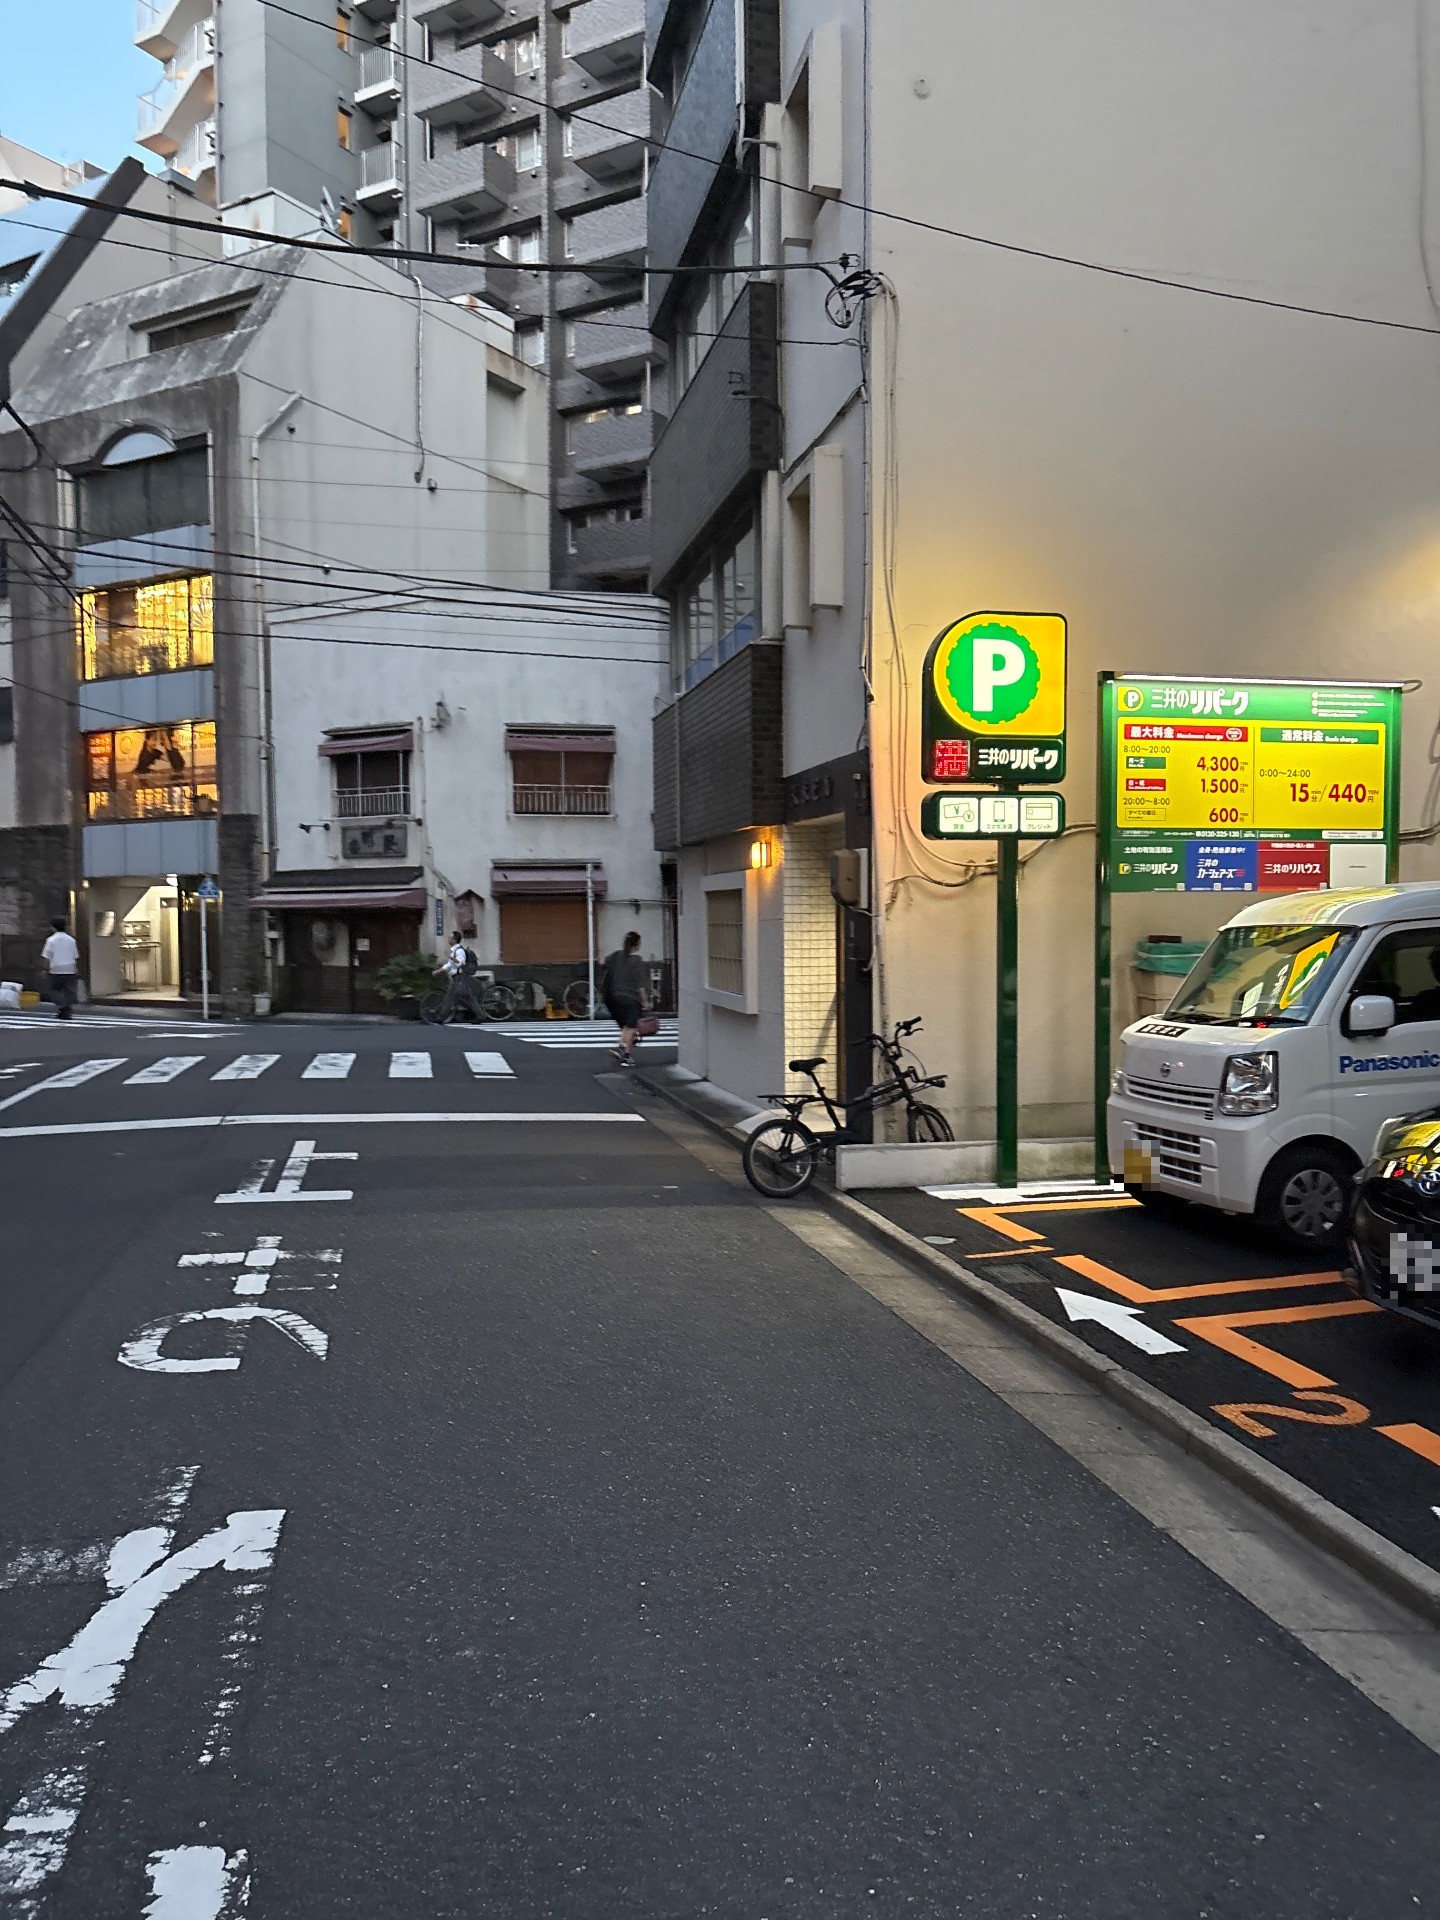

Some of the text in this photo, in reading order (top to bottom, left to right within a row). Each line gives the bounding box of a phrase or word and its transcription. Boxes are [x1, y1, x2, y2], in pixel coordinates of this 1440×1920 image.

[973, 638, 1025, 712] P
[1127, 687, 1249, 715] P 三井のリパーク
[1131, 726, 1174, 739] 最大料金
[1281, 729, 1324, 741] 通常料金
[978, 748, 1059, 770] 三井のリパーク
[1196, 756, 1239, 772] 4,300
[1201, 778, 1239, 794] 1,500
[1289, 782, 1309, 802] 15
[1328, 782, 1367, 803] 440
[1209, 807, 1239, 823] 600
[1133, 862, 1178, 874] 三井のリパーク
[1196, 858, 1218, 867] 三井の
[1263, 862, 1321, 874] 三井のリハウス
[1339, 1051, 1440, 1074] Panasonic
[1209, 1390, 1370, 1438] 2
